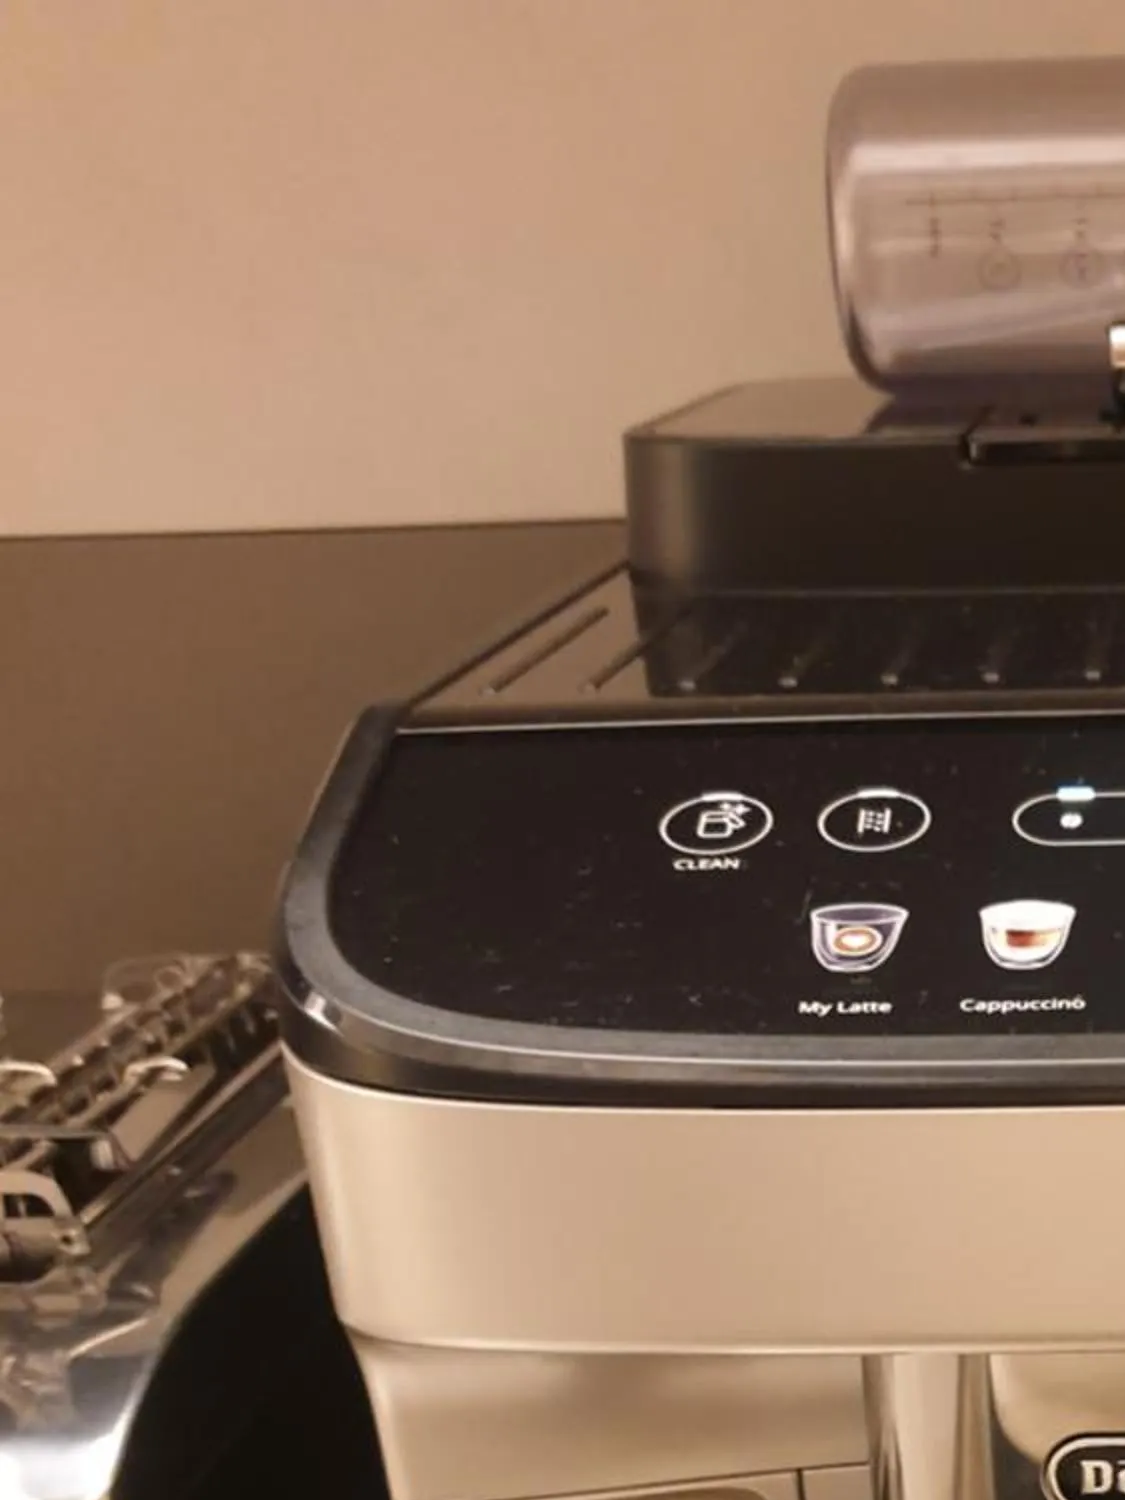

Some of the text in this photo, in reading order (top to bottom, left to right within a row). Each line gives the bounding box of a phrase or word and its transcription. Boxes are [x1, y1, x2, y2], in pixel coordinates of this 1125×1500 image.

[673, 857, 741, 871] CLEAN
[798, 1000, 893, 1018] My Latte
